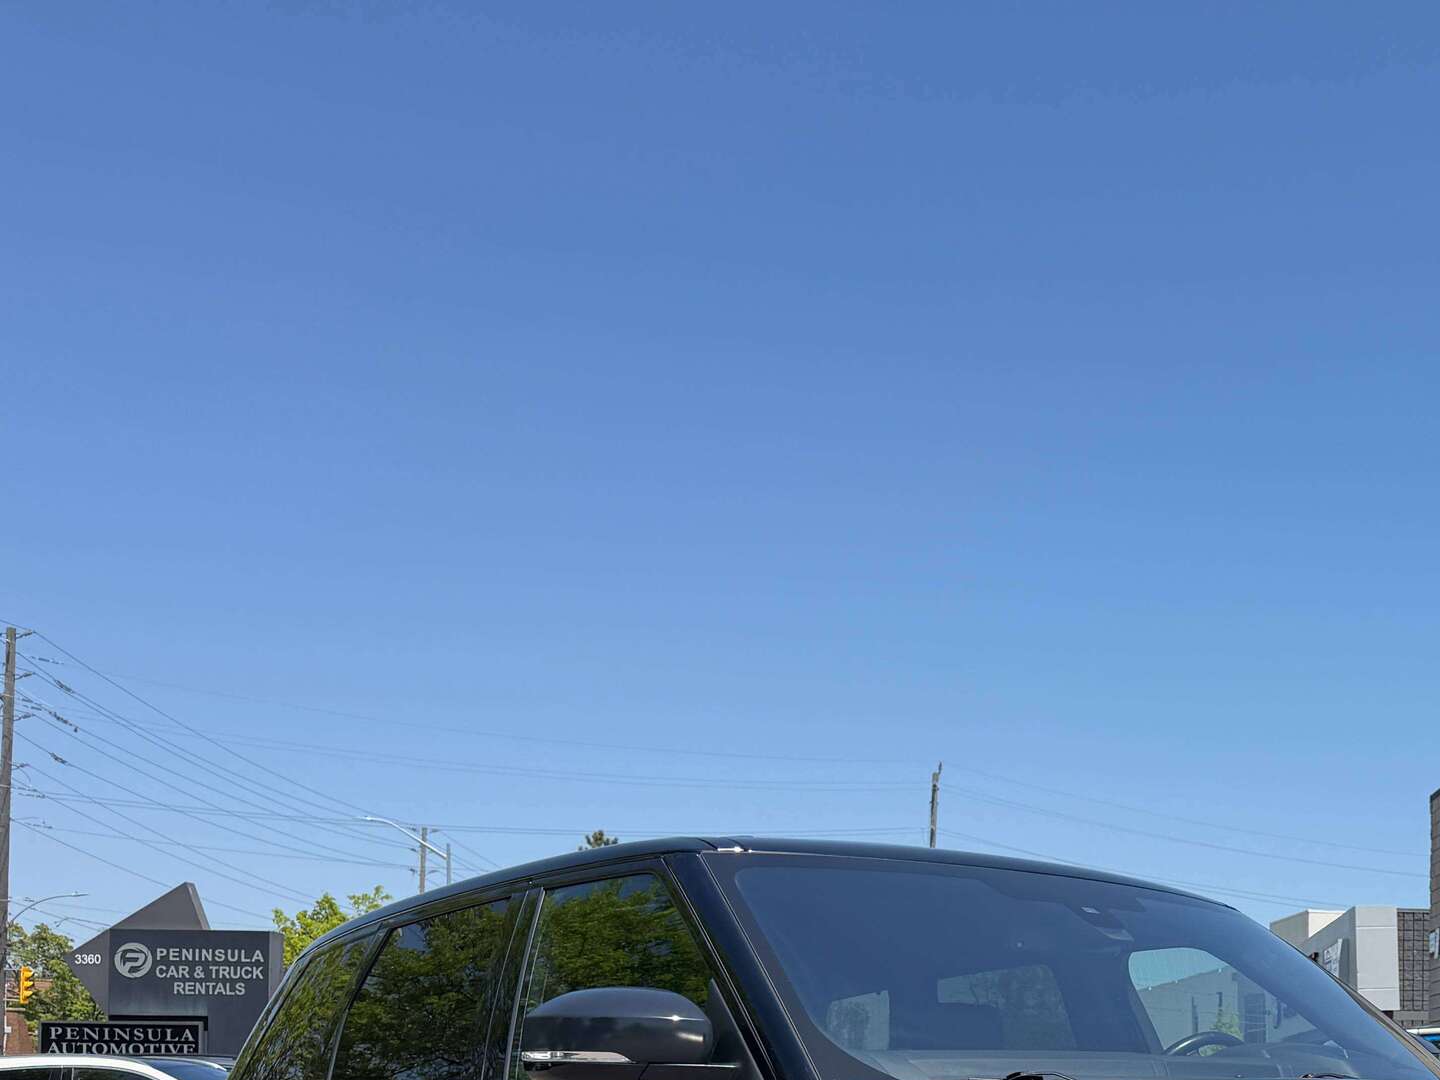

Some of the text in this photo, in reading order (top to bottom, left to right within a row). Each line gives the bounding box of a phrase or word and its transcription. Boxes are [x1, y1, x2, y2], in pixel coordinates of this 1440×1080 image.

[74, 953, 102, 965] 3360
[156, 948, 264, 963] PENINSULA
[155, 965, 264, 980] CAR & TRUCK
[173, 982, 246, 996] RENTALS
[49, 1026, 195, 1042] PENINSULA
[47, 1041, 196, 1054] AUTOMOTIVE
